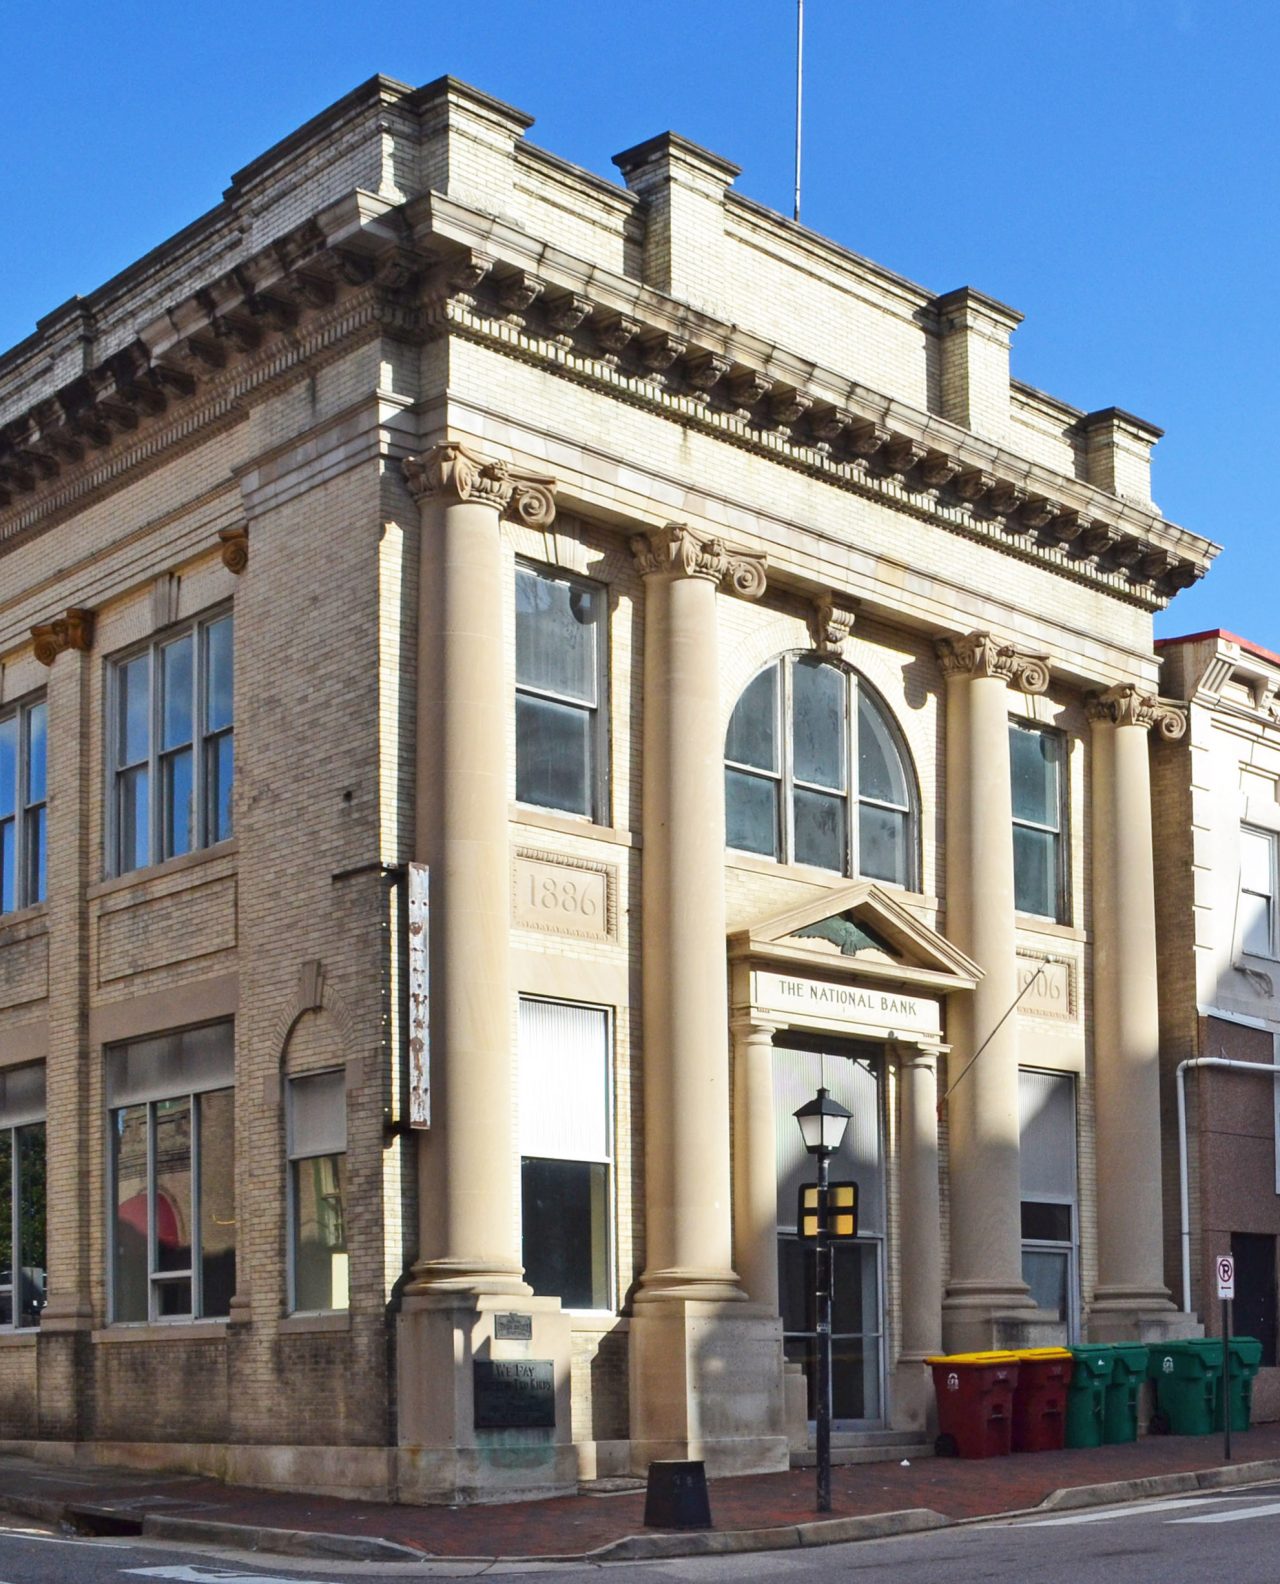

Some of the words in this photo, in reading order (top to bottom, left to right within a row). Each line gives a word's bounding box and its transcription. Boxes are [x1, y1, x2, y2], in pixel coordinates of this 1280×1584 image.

[529, 874, 596, 916] 1886
[779, 980, 804, 997] THE
[810, 985, 875, 1009] NATIONAL
[881, 997, 917, 1016] BANK
[1016, 968, 1060, 999] 1906
[515, 1363, 534, 1377] PAY
